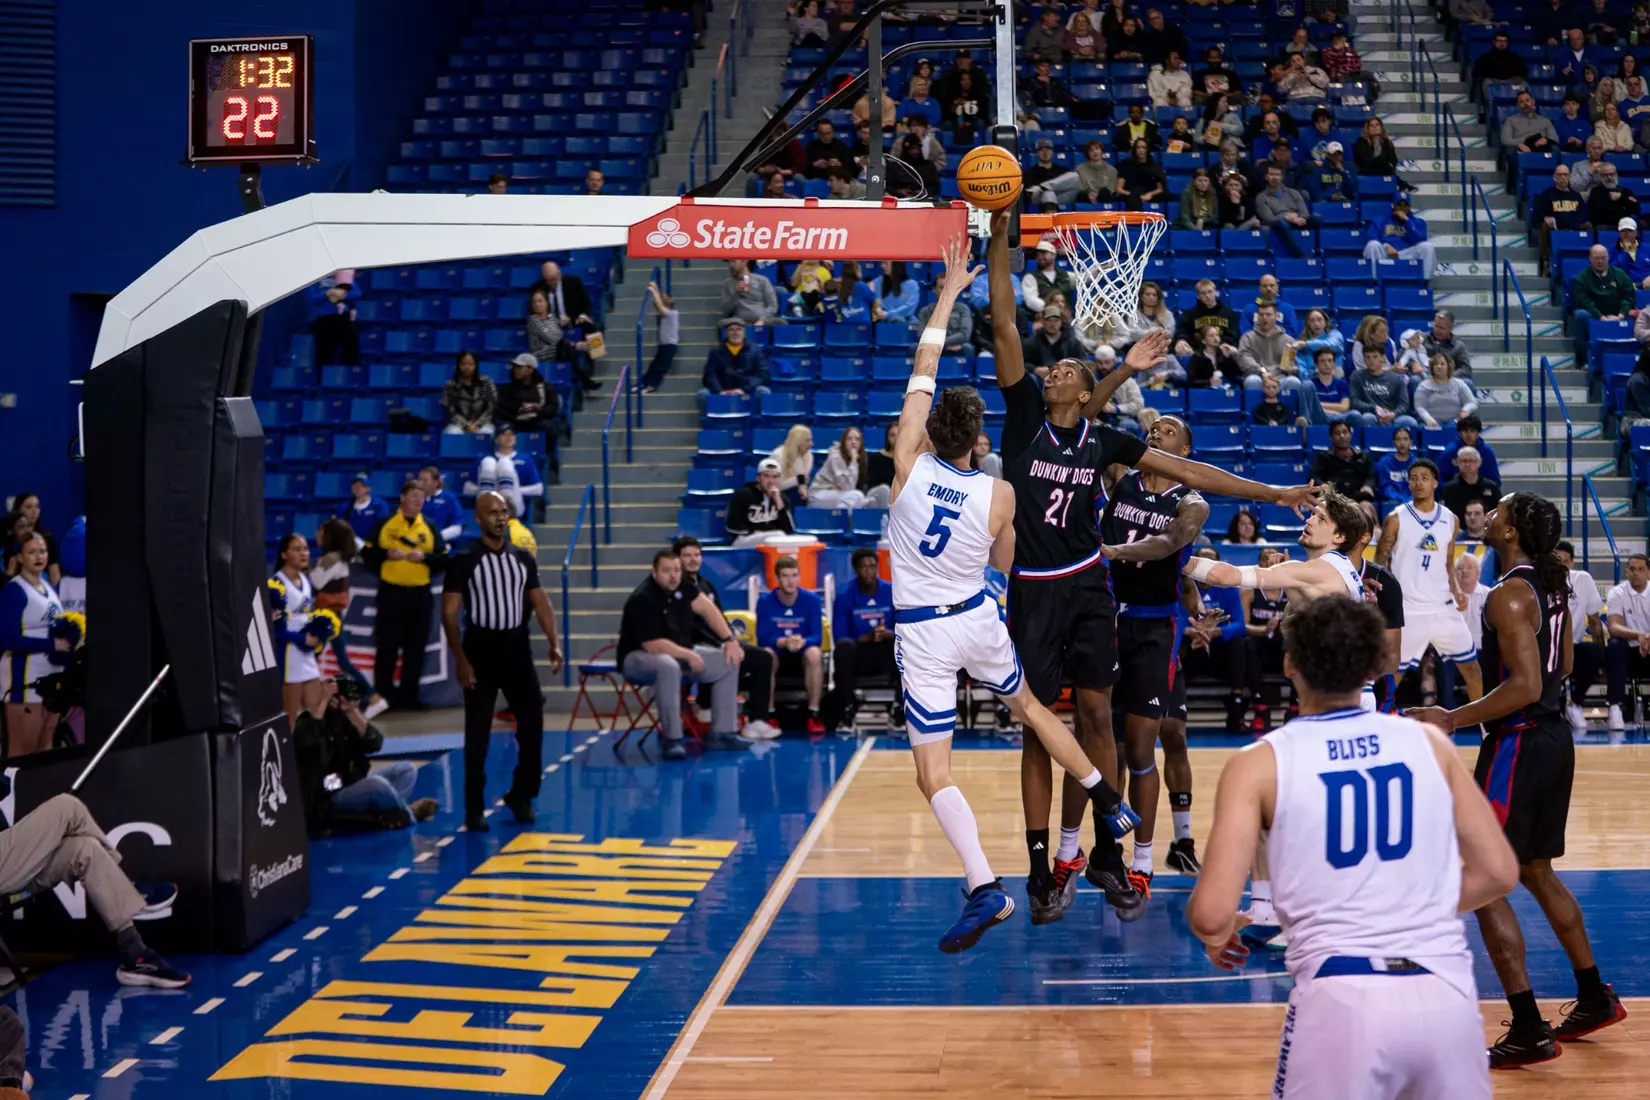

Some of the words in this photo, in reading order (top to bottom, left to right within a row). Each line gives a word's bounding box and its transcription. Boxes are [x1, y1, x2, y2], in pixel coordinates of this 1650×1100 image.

[210, 43, 288, 52] DAKTRONICS
[239, 56, 293, 88] 1:32
[223, 96, 278, 139] 22
[968, 181, 1011, 195] Wilson
[694, 219, 771, 250] State
[773, 220, 848, 250] Farm
[1029, 459, 1072, 484] DUNKIN'
[1538, 462, 1557, 474] LOVE
[927, 482, 968, 507] EMORY
[1044, 488, 1075, 528] 21
[1113, 501, 1151, 525] DUNKIN'
[918, 504, 961, 558] 5
[1421, 554, 1431, 571] 4
[1546, 611, 1564, 673] 11
[1326, 734, 1380, 761] BLISS
[1317, 762, 1413, 871] 00
[206, 832, 738, 1096] DELAWARE
